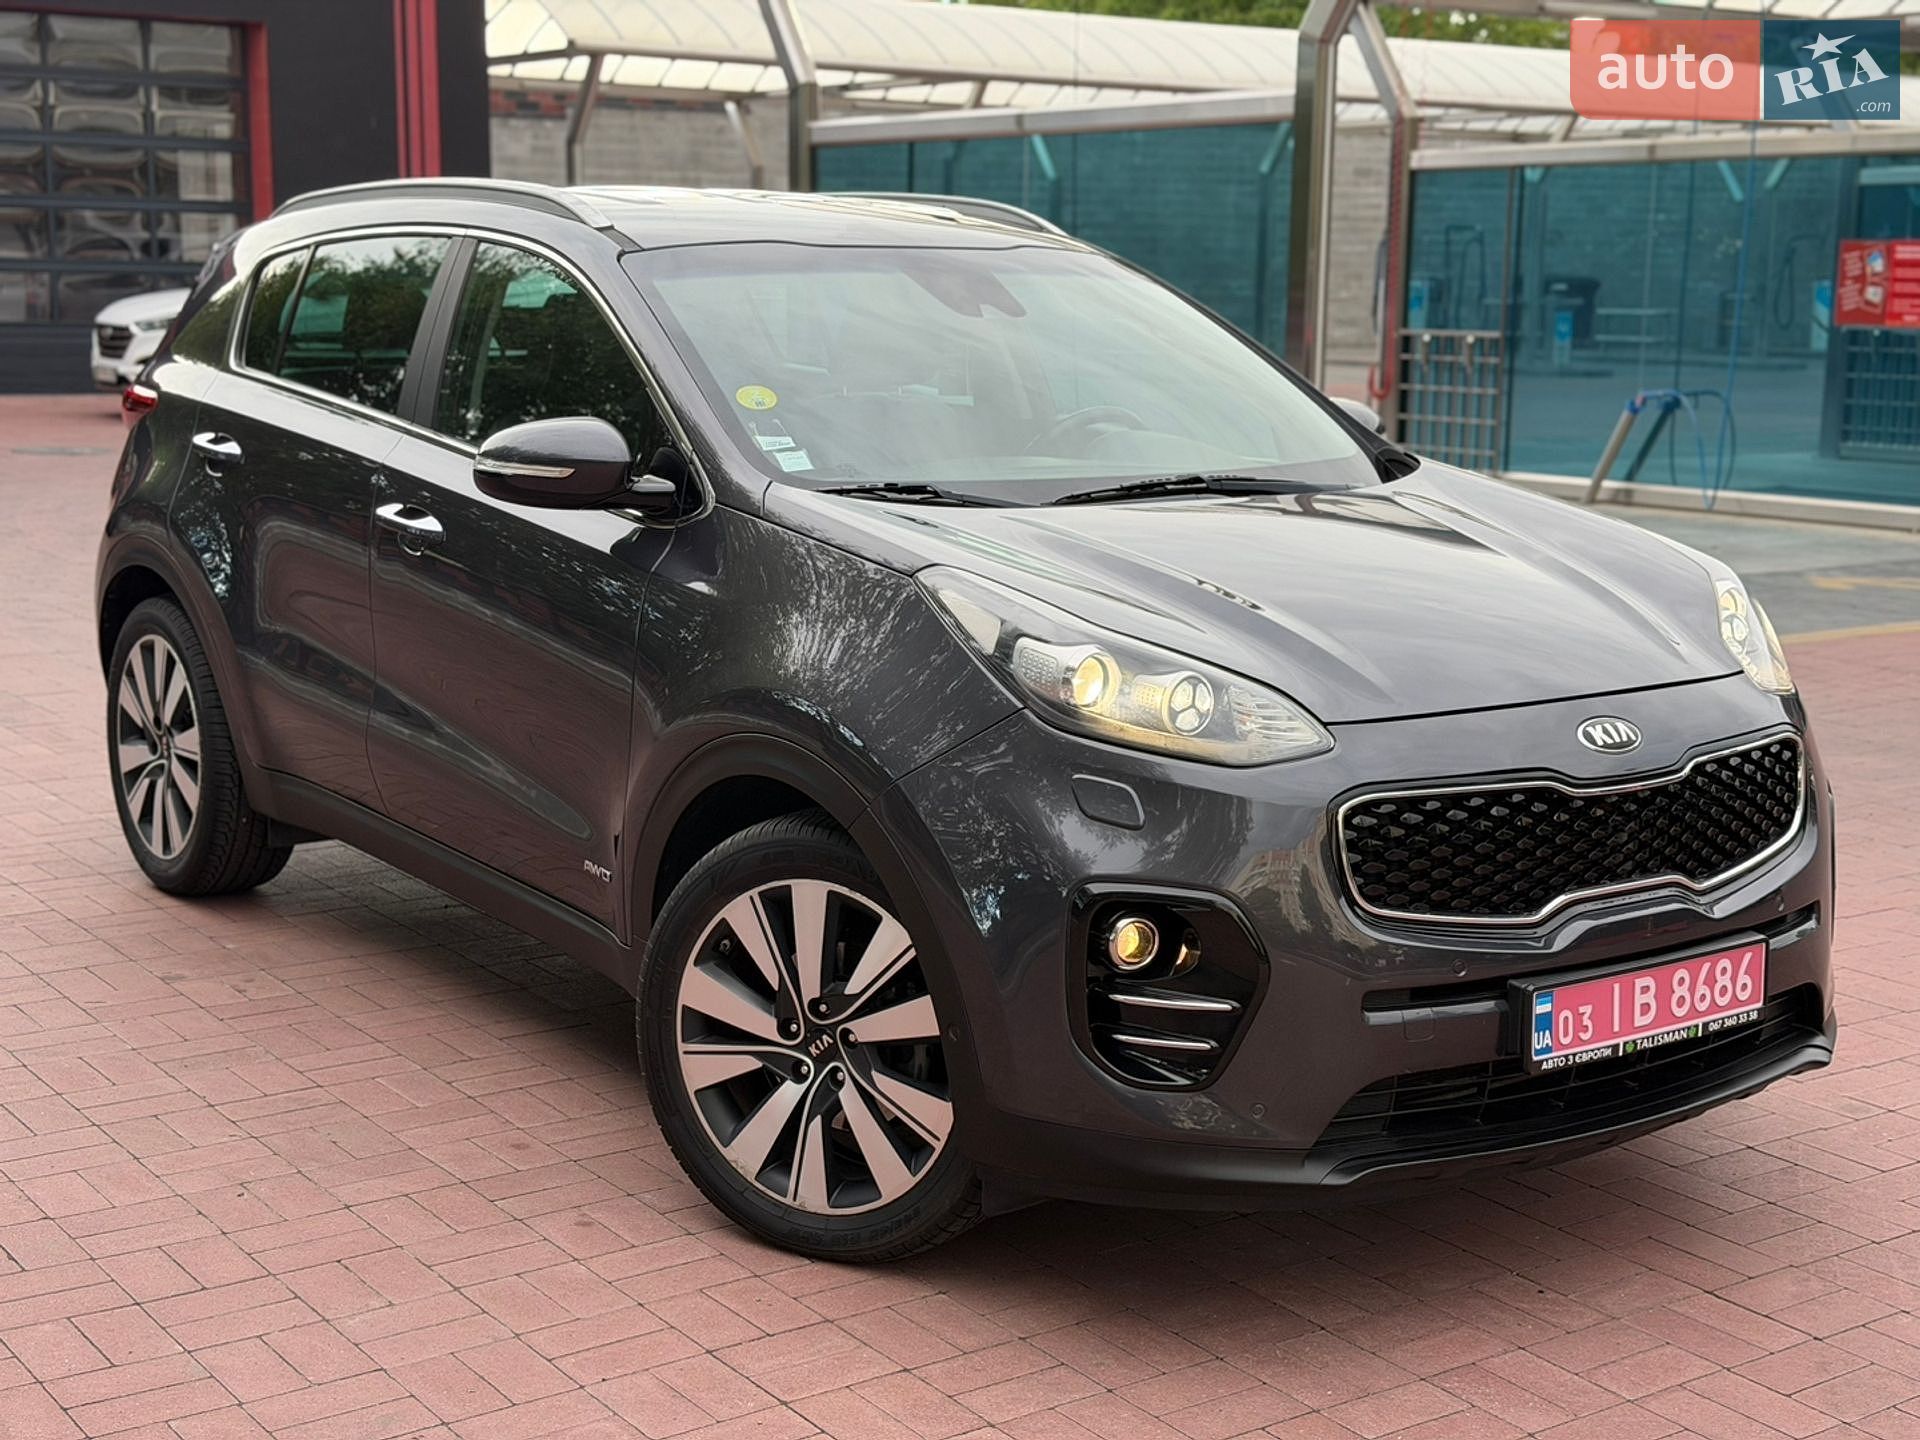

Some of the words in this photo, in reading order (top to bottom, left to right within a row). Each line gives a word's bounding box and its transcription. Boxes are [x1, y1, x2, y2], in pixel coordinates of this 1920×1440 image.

[1585, 721, 1637, 746] KIA
[584, 859, 611, 883] AWD
[1558, 1004, 1594, 1046] 03
[1670, 951, 1753, 1018] 8686
[808, 1034, 834, 1057] KIA
[1534, 1029, 1552, 1049] UA
[1636, 1028, 1688, 1050] TALISMAN
[1541, 1056, 1567, 1071] АВТО
